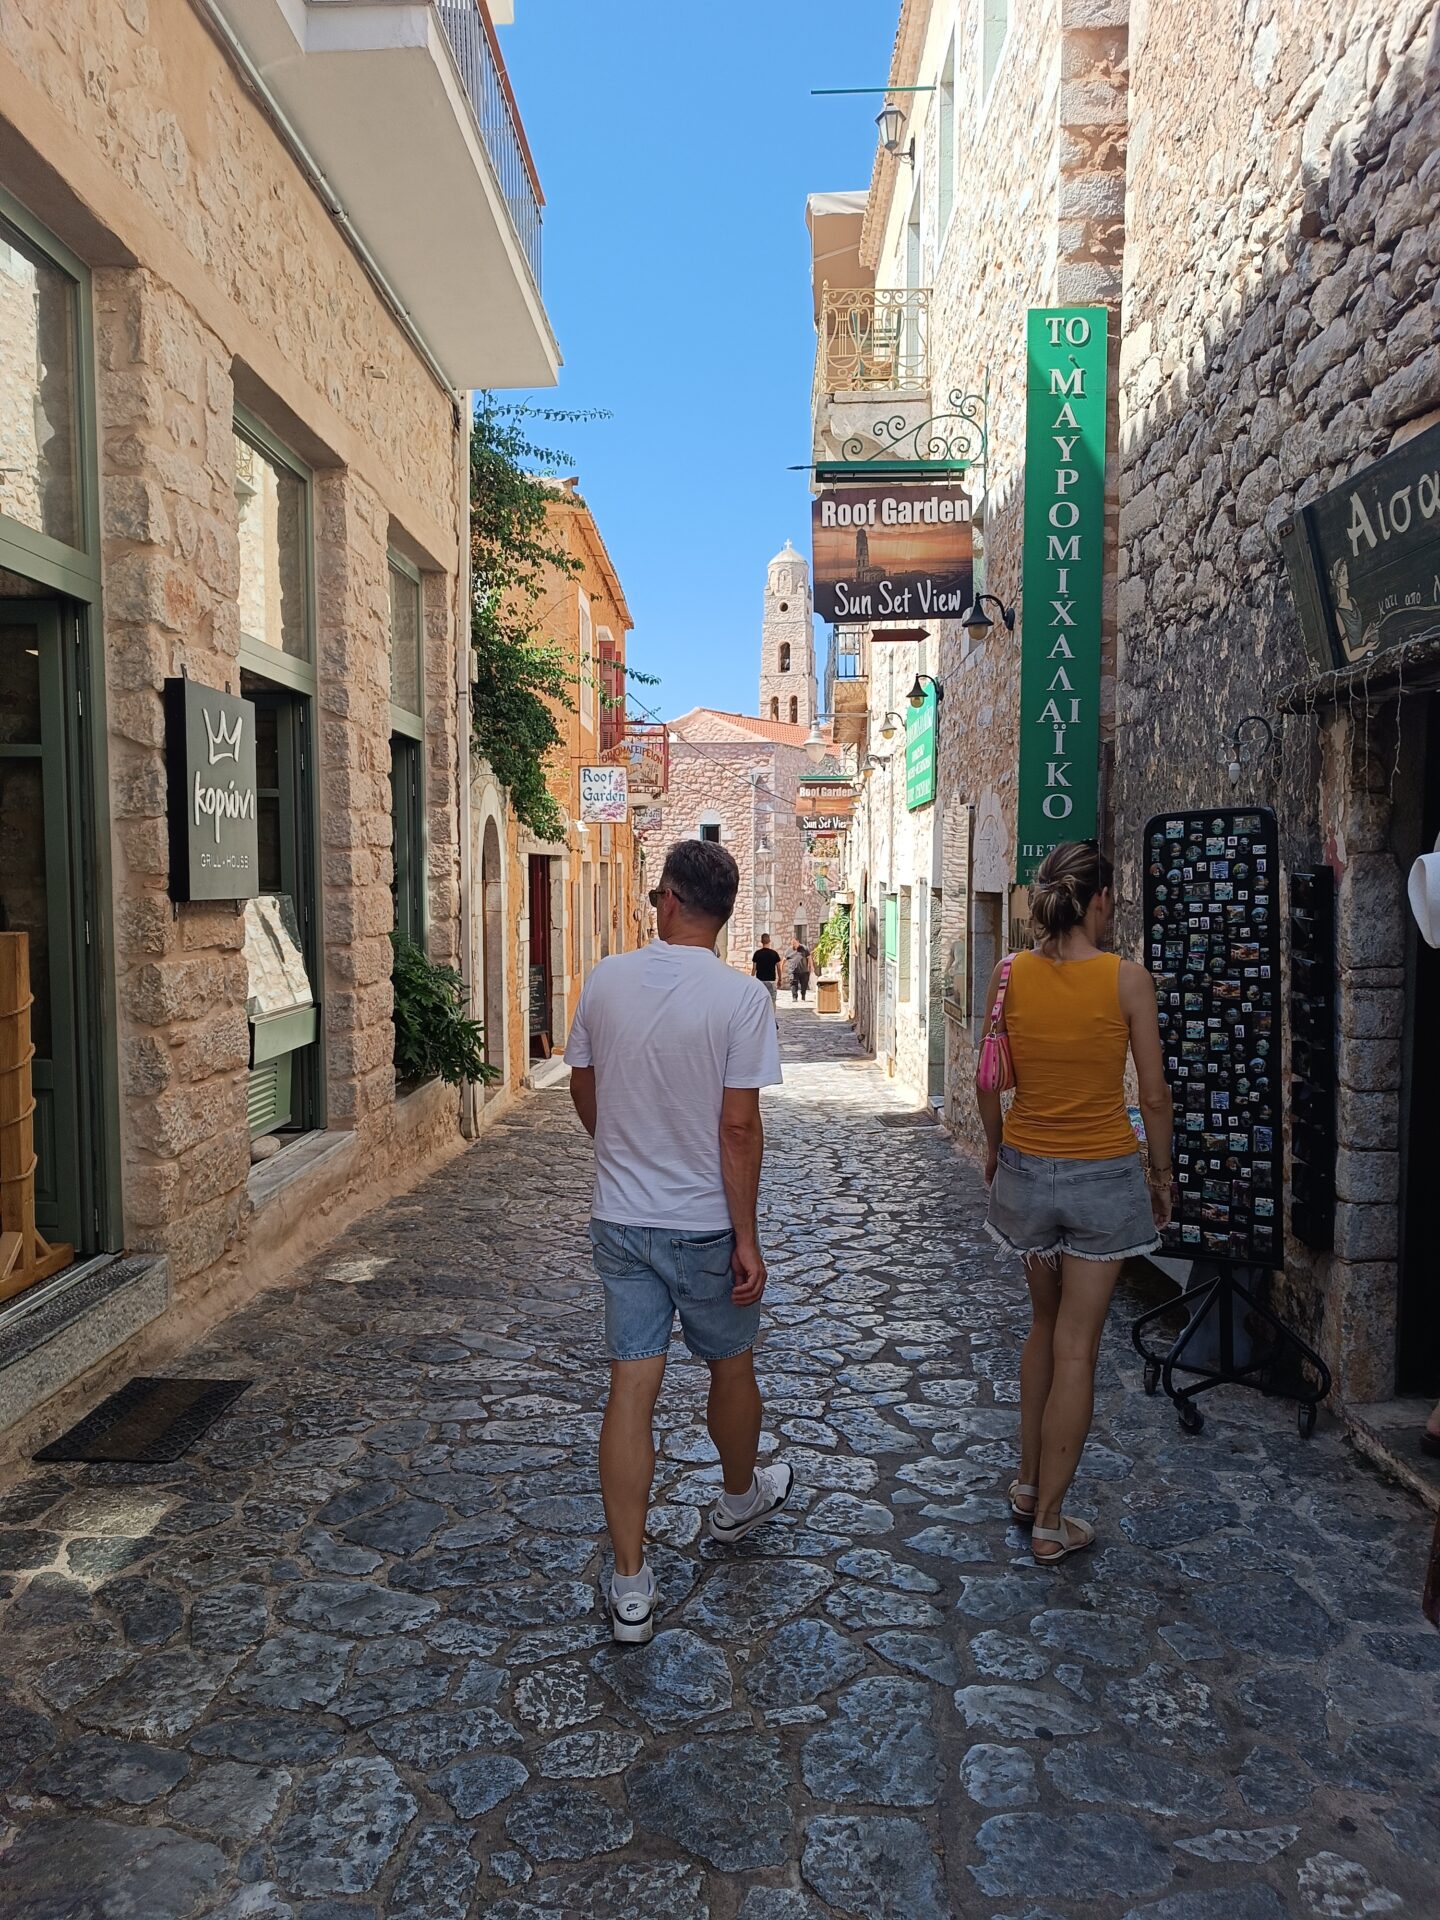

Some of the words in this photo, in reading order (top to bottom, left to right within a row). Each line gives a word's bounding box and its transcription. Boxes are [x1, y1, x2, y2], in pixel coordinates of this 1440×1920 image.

[1045, 316, 1090, 345] ΤΟ
[821, 498, 877, 527] Roof
[882, 496, 970, 525] Garden
[834, 582, 873, 616] Sun
[878, 580, 912, 615] Set
[917, 579, 961, 614] View
[582, 768, 614, 785] Roof
[582, 786, 625, 802] Garden
[799, 786, 820, 797] Roof
[821, 786, 853, 797] Garden
[803, 816, 817, 829] Sun
[818, 816, 831, 829] Set
[832, 816, 846, 829] Vie
[1022, 844, 1056, 857] ΠΕΤ
